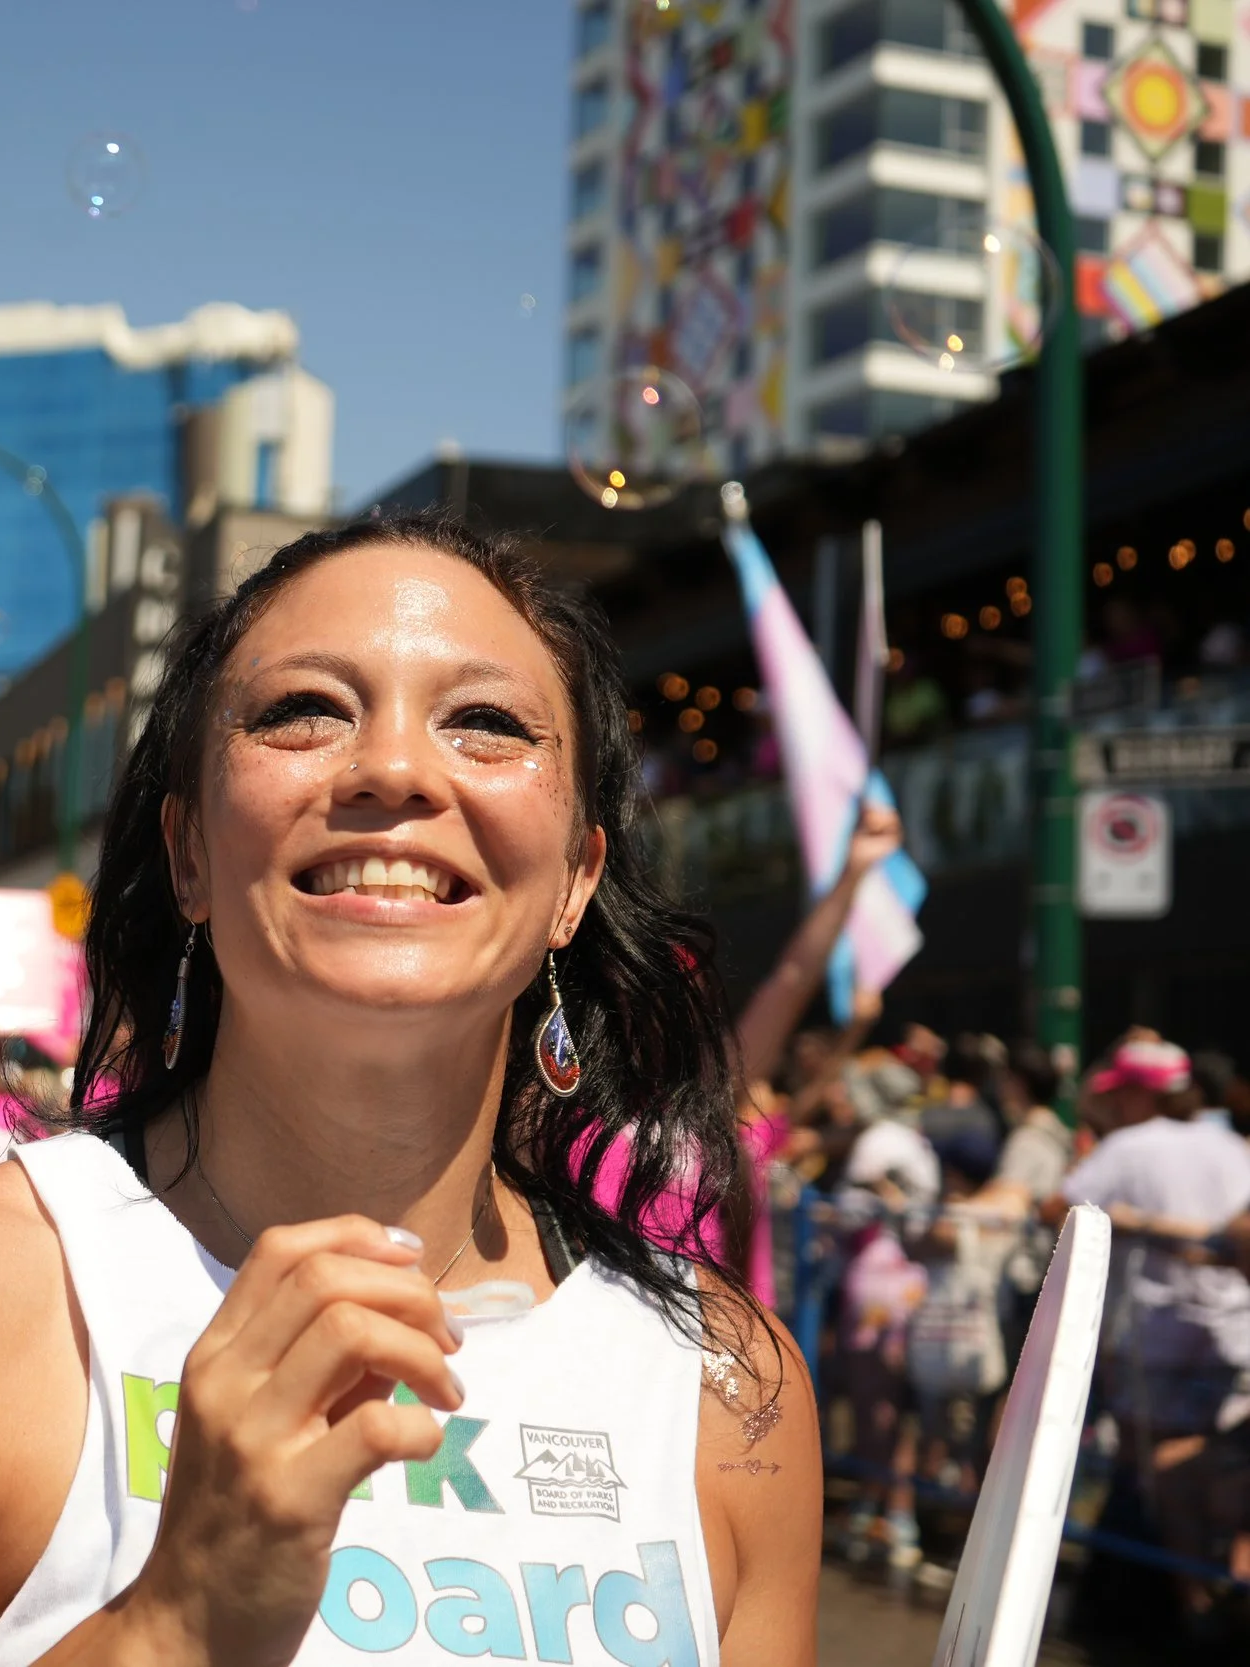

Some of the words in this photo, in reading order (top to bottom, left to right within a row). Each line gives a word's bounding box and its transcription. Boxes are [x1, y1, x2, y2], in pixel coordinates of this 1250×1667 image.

[121, 1371, 505, 1514] pk
[526, 1431, 605, 1449] VANCOUVER
[535, 1488, 567, 1499] BOARD
[570, 1490, 583, 1499] OF
[586, 1491, 614, 1502] PARKS
[537, 1499, 557, 1509] AND
[559, 1500, 615, 1513] RECREATION
[318, 1540, 700, 1667] oard
